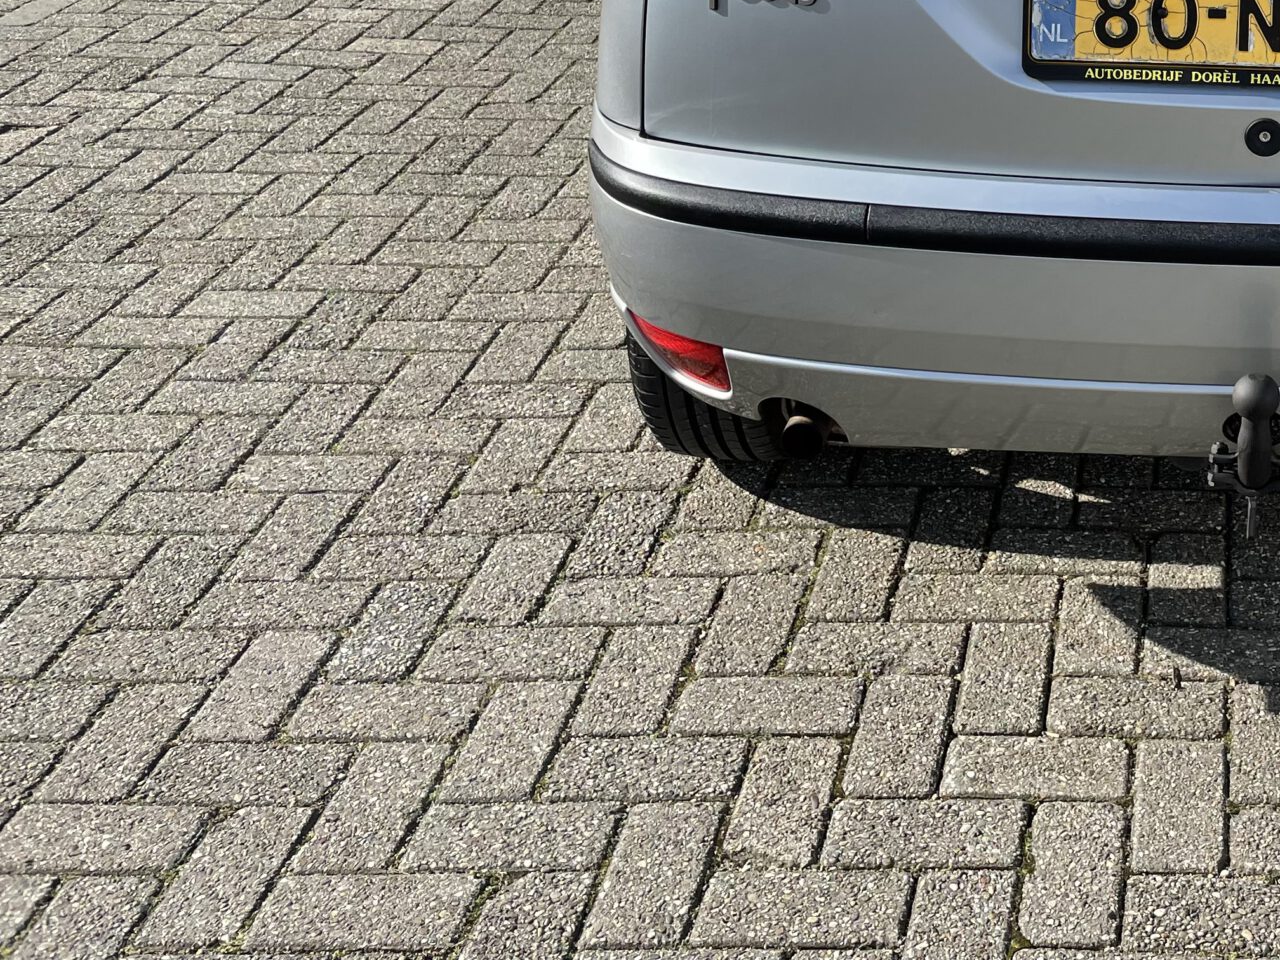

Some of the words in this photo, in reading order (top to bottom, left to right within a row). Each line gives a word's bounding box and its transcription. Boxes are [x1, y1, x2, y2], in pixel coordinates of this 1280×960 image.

[1039, 23, 1068, 43] NL
[1085, 67, 1183, 82] AUTOBEDRIJF
[1191, 69, 1240, 84] DORÈL
